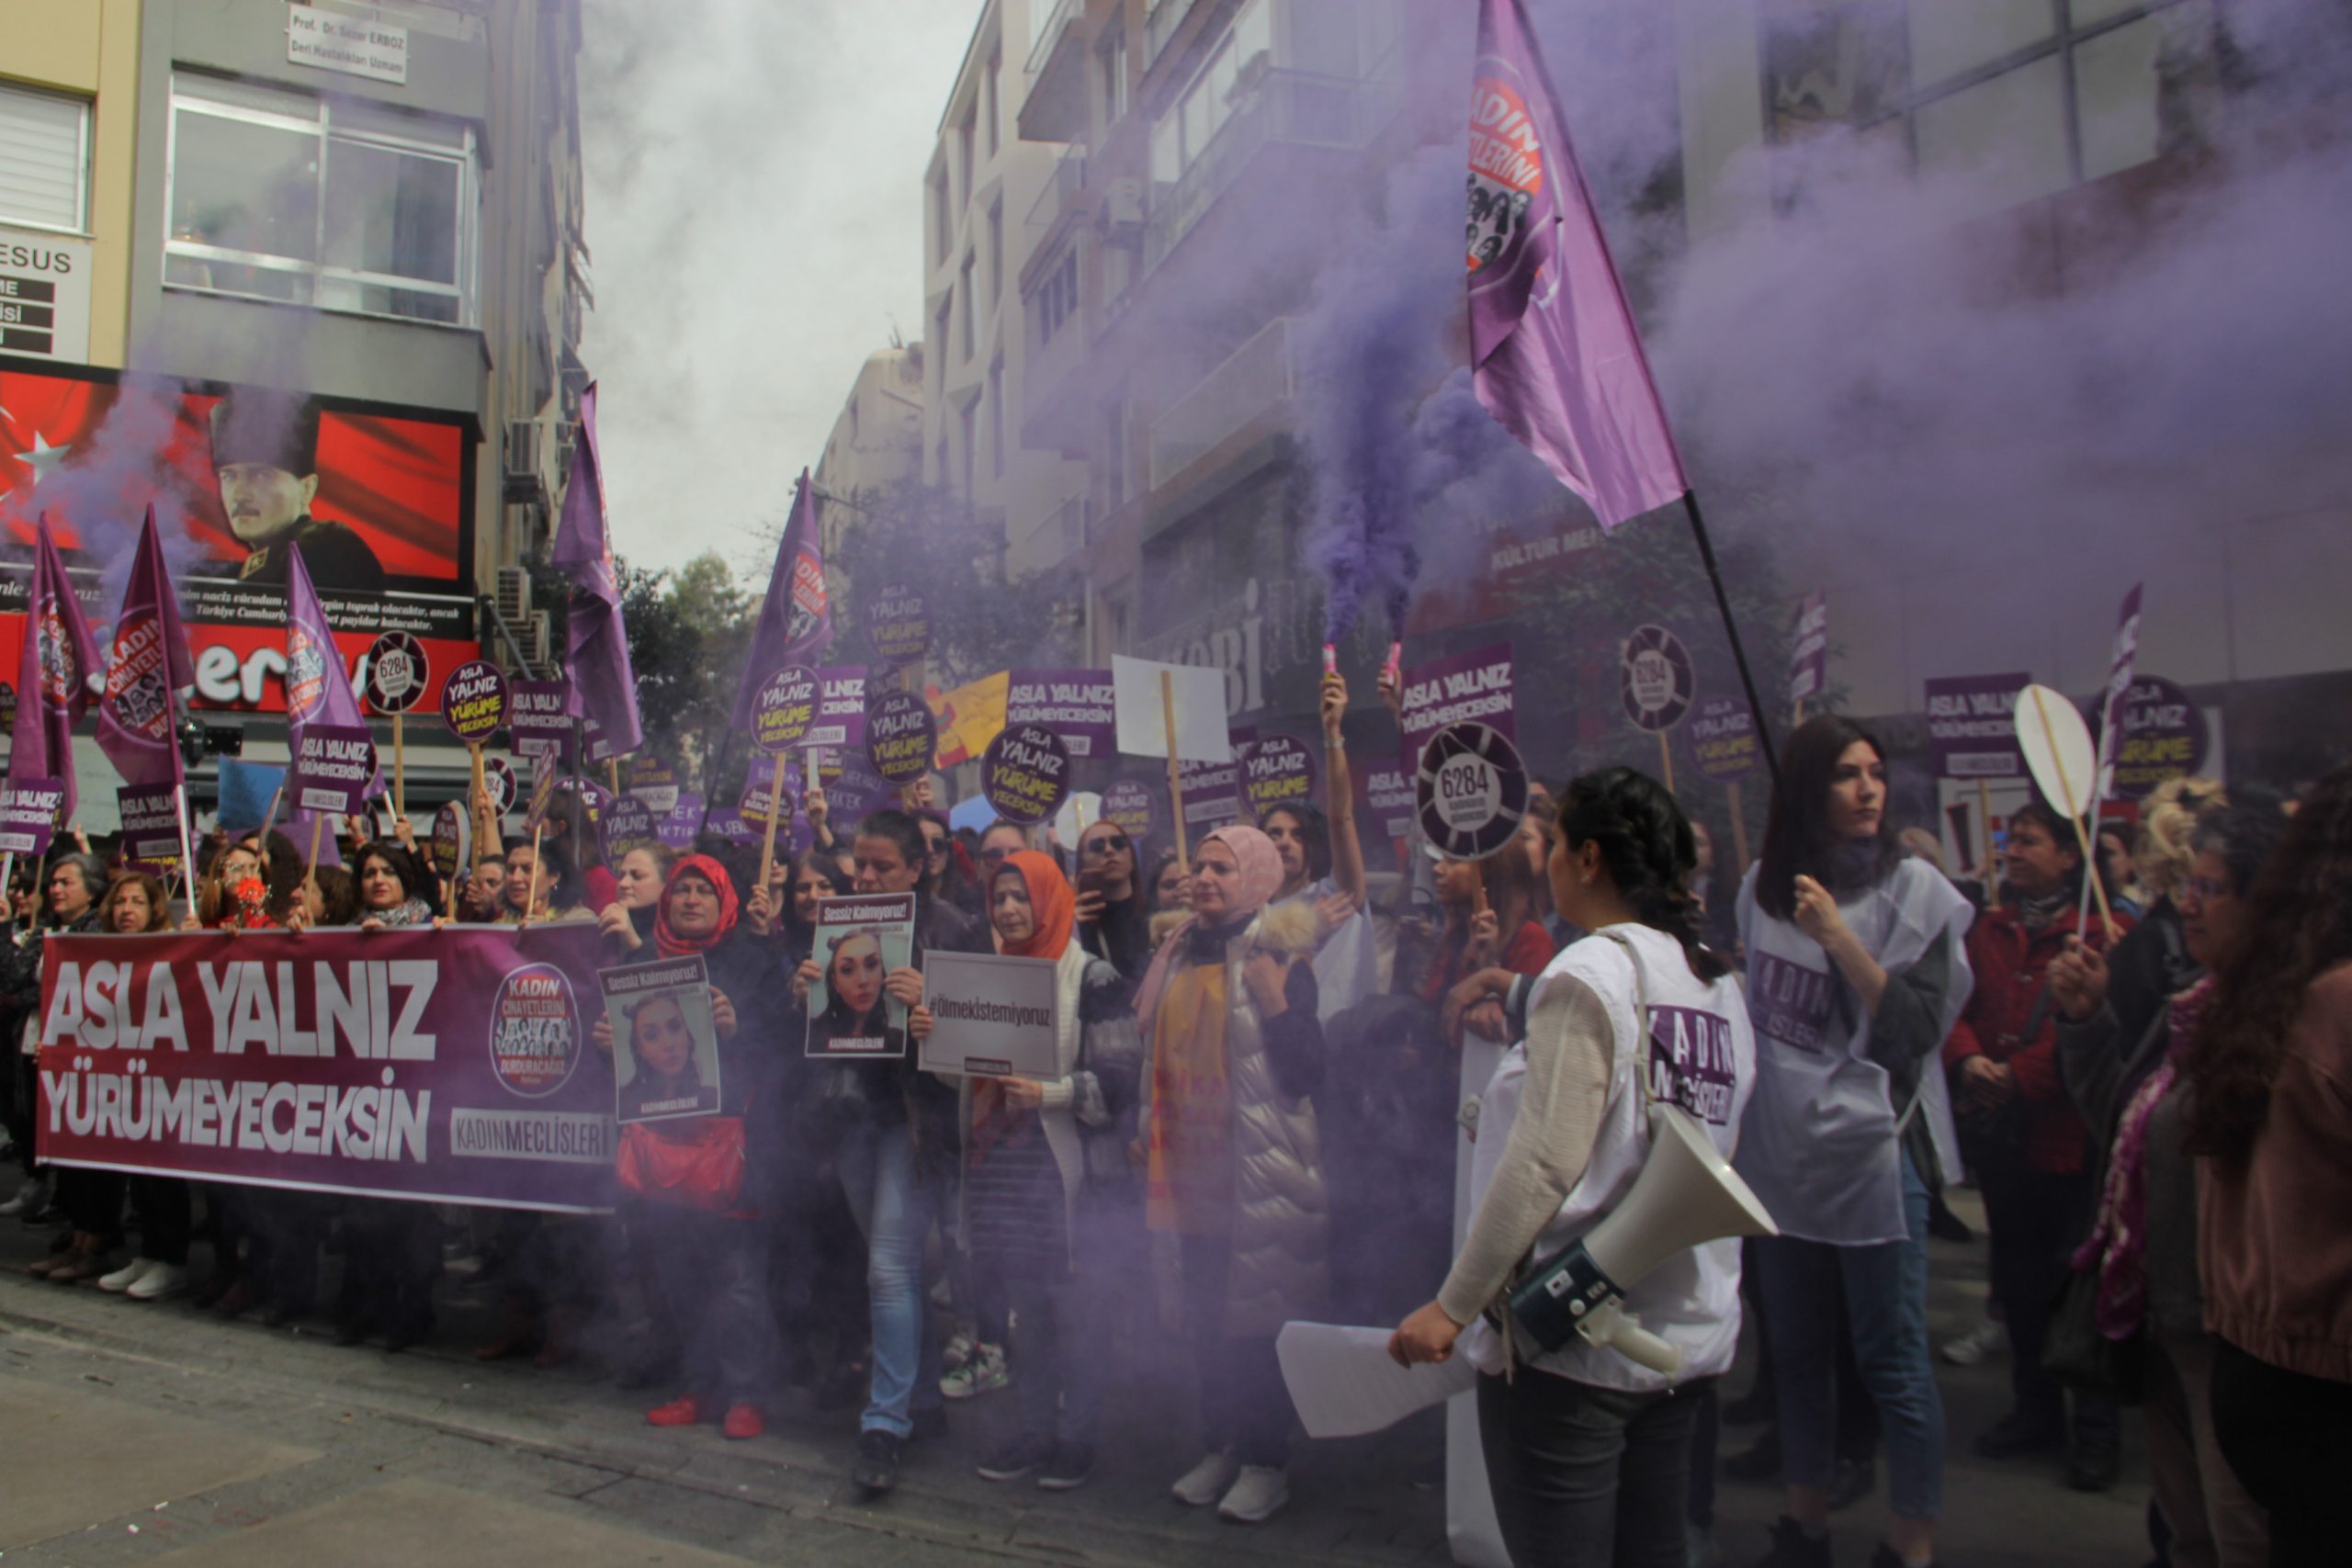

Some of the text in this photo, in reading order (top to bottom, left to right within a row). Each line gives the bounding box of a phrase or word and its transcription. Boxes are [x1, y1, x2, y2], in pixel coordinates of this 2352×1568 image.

[293, 15, 316, 30] Prof.
[322, 21, 336, 35] Dr.
[291, 39, 311, 54] Deri
[379, 656, 408, 678] 6284
[460, 664, 484, 681] ASLA
[775, 670, 801, 685] ASLA
[448, 675, 498, 702] YALNIZ
[762, 682, 814, 708] YALNIZ
[1010, 683, 1114, 705] ASLA YALNIZ
[1403, 662, 1513, 712] ASLA YALNIZ
[450, 695, 502, 723] YÜRÜME
[758, 703, 812, 730] YÜRÜME
[885, 697, 910, 713] ASLA
[1008, 705, 1113, 724] YÜRÜMEYECEKSİN
[1402, 691, 1513, 734] YÜRÜMEYECEKSİN
[871, 711, 924, 738] YALNIZ
[1691, 713, 1750, 739] YALNIZ
[300, 737, 369, 761] ASLA YALNIZ
[874, 735, 928, 762] YÜRÜME
[1020, 728, 1052, 749] ASLA
[1260, 739, 1291, 754] ASLA
[1001, 738, 1064, 775] YALNIZ
[1247, 752, 1306, 778] YALNIZ
[991, 763, 1058, 802] YÜRÜME
[1248, 773, 1309, 802] YÜRÜME
[1369, 772, 1406, 791] ASLA
[1441, 763, 1489, 799] 6284
[16, 790, 57, 809] YALNIZ
[1105, 794, 1149, 810] YALNIZ
[606, 815, 649, 835] YALNIZ
[824, 903, 907, 921] Sessiz Kalmıyoruz!
[509, 978, 560, 998] KADIN
[607, 973, 639, 991] Sessiz
[639, 964, 698, 987] Kalmıyoruz!
[42, 959, 439, 1062] ASLA YALNIZ
[40, 1056, 432, 1164] YÜRÜMEYECEKSİN
